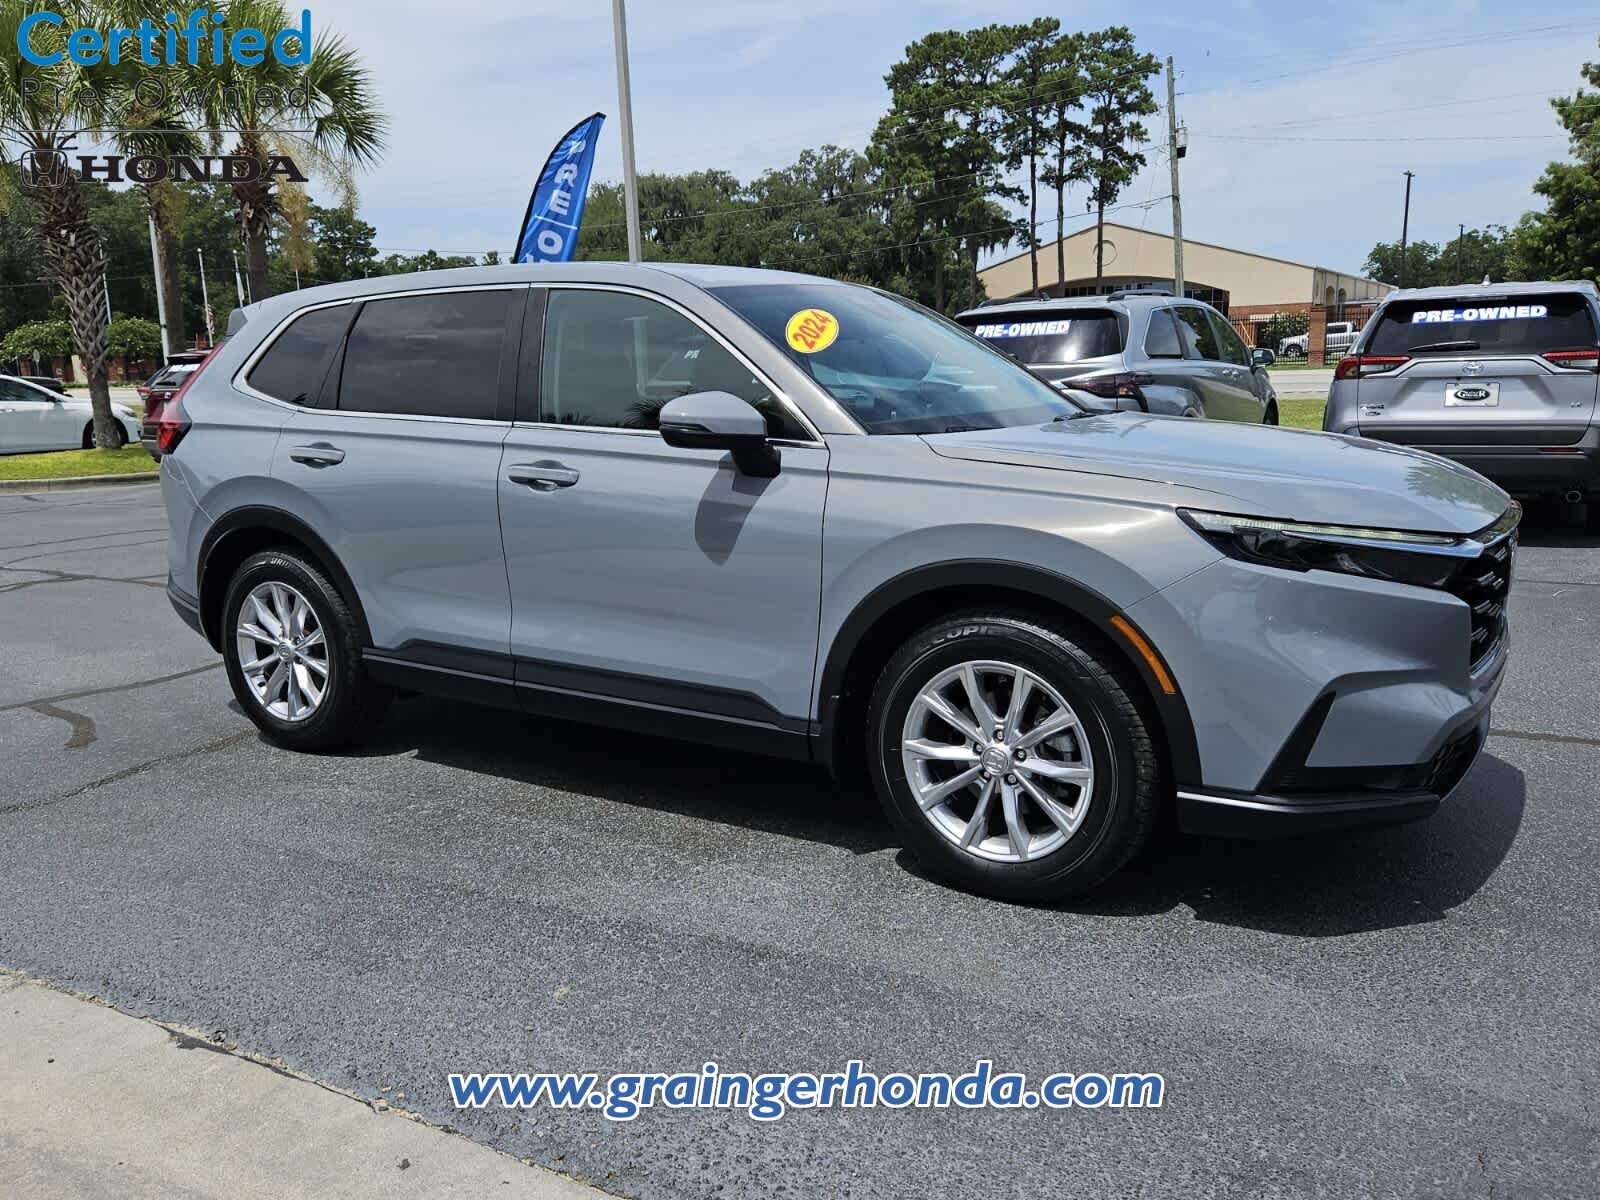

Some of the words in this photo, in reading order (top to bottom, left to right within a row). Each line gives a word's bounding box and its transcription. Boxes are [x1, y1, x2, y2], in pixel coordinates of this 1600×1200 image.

[1412, 305, 1547, 323] PRE-OWNED
[793, 310, 832, 349] 2024
[975, 320, 1071, 337] PRE-OWNED
